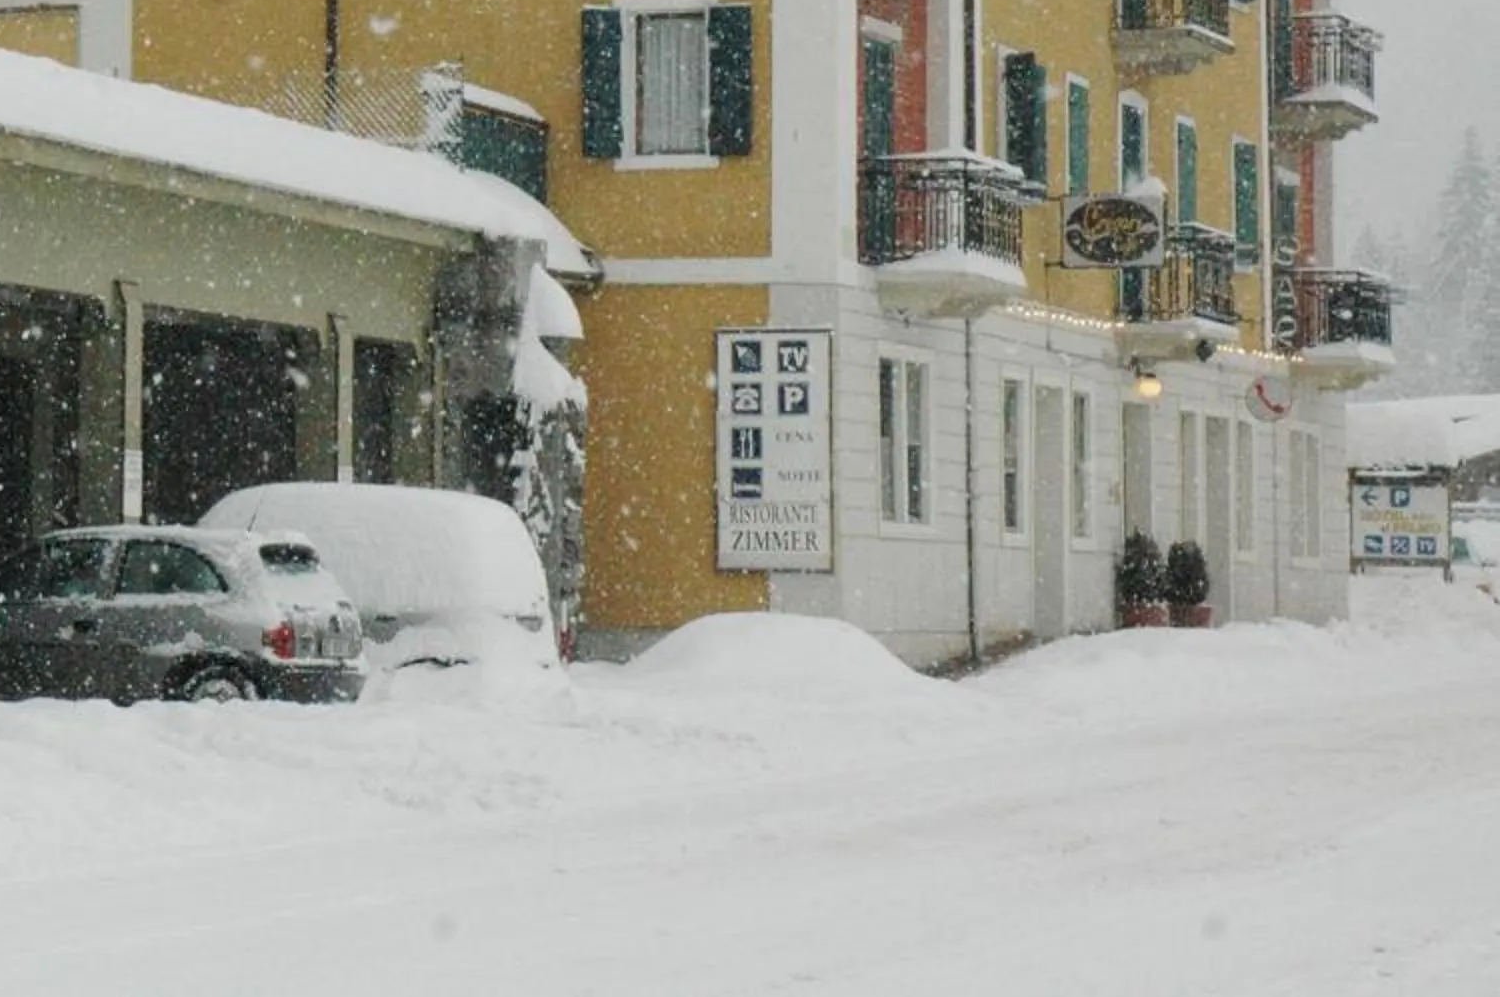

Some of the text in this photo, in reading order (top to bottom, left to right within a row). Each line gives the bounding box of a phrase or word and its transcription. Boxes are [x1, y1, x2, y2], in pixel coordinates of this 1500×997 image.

[779, 346, 808, 367] TV
[784, 386, 804, 412] P
[731, 530, 820, 552] ZIMMER
